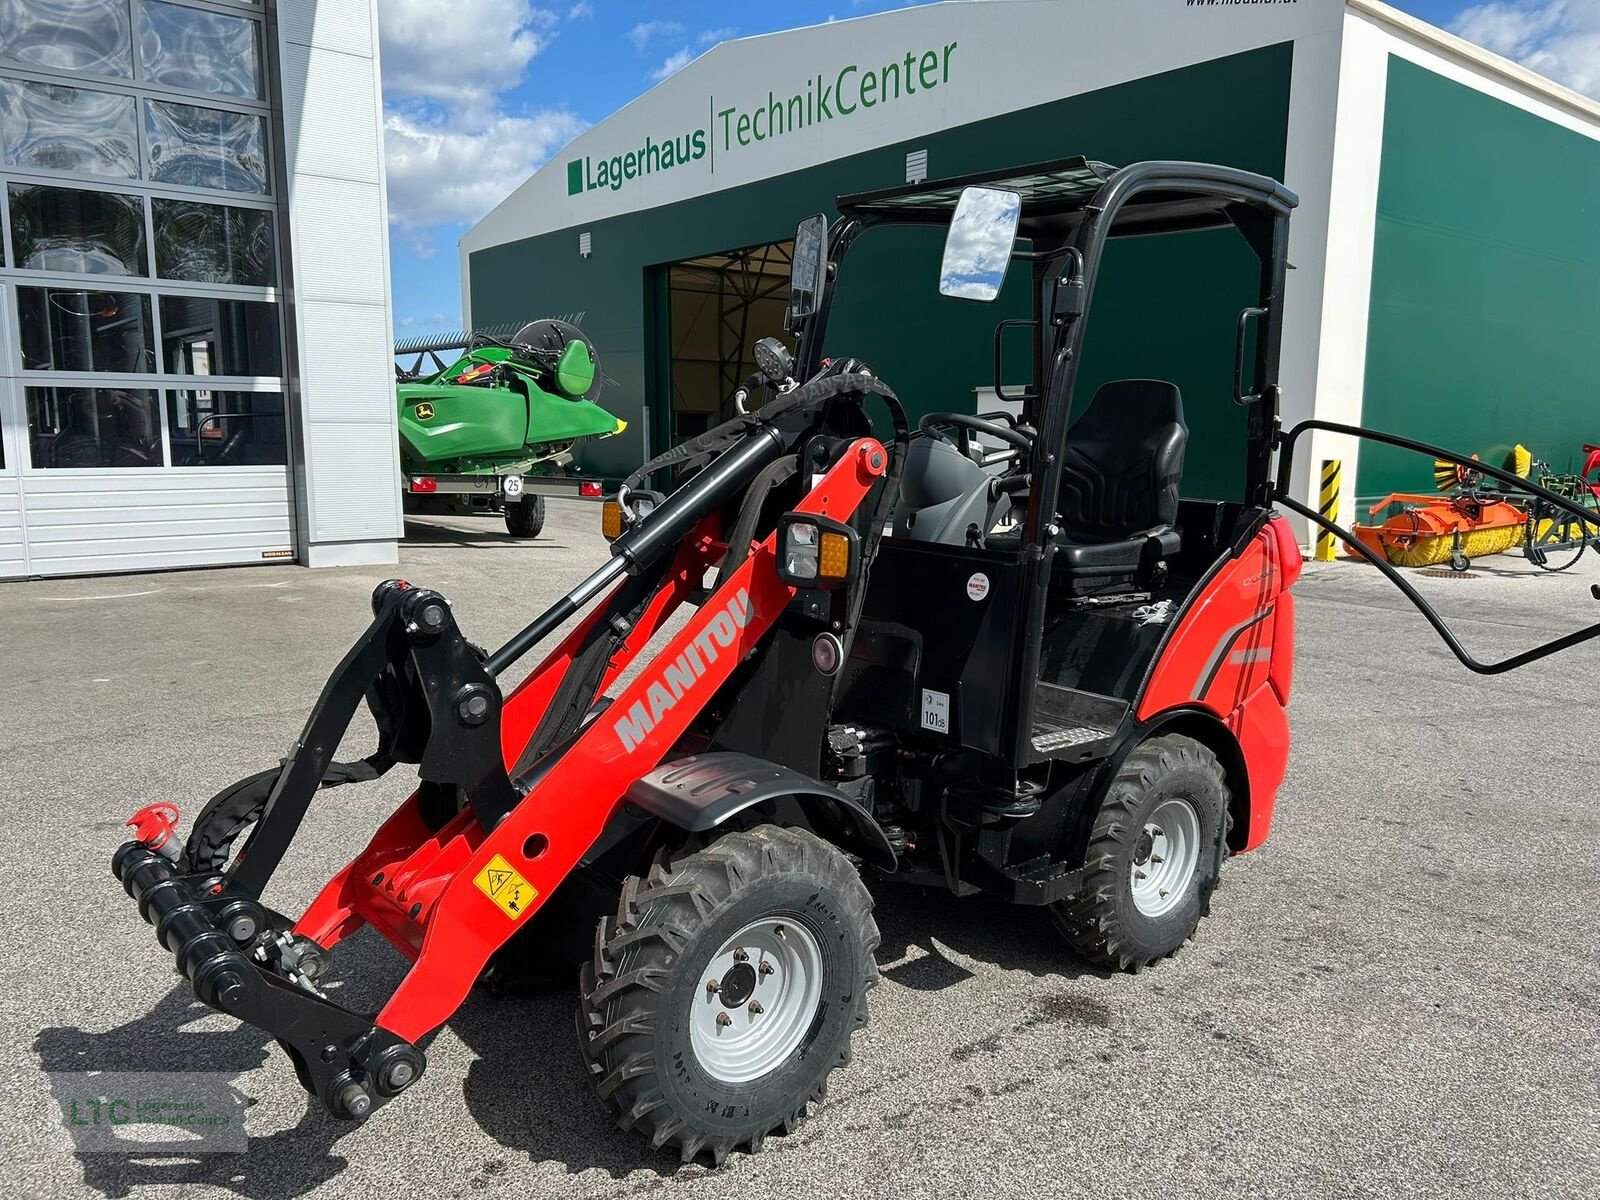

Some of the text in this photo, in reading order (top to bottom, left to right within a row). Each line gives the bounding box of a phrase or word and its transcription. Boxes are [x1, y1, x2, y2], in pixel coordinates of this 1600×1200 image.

[586, 41, 958, 192] Lagerhaus TechnikCenter
[508, 479, 519, 492] 25
[613, 587, 754, 754] MANITOU
